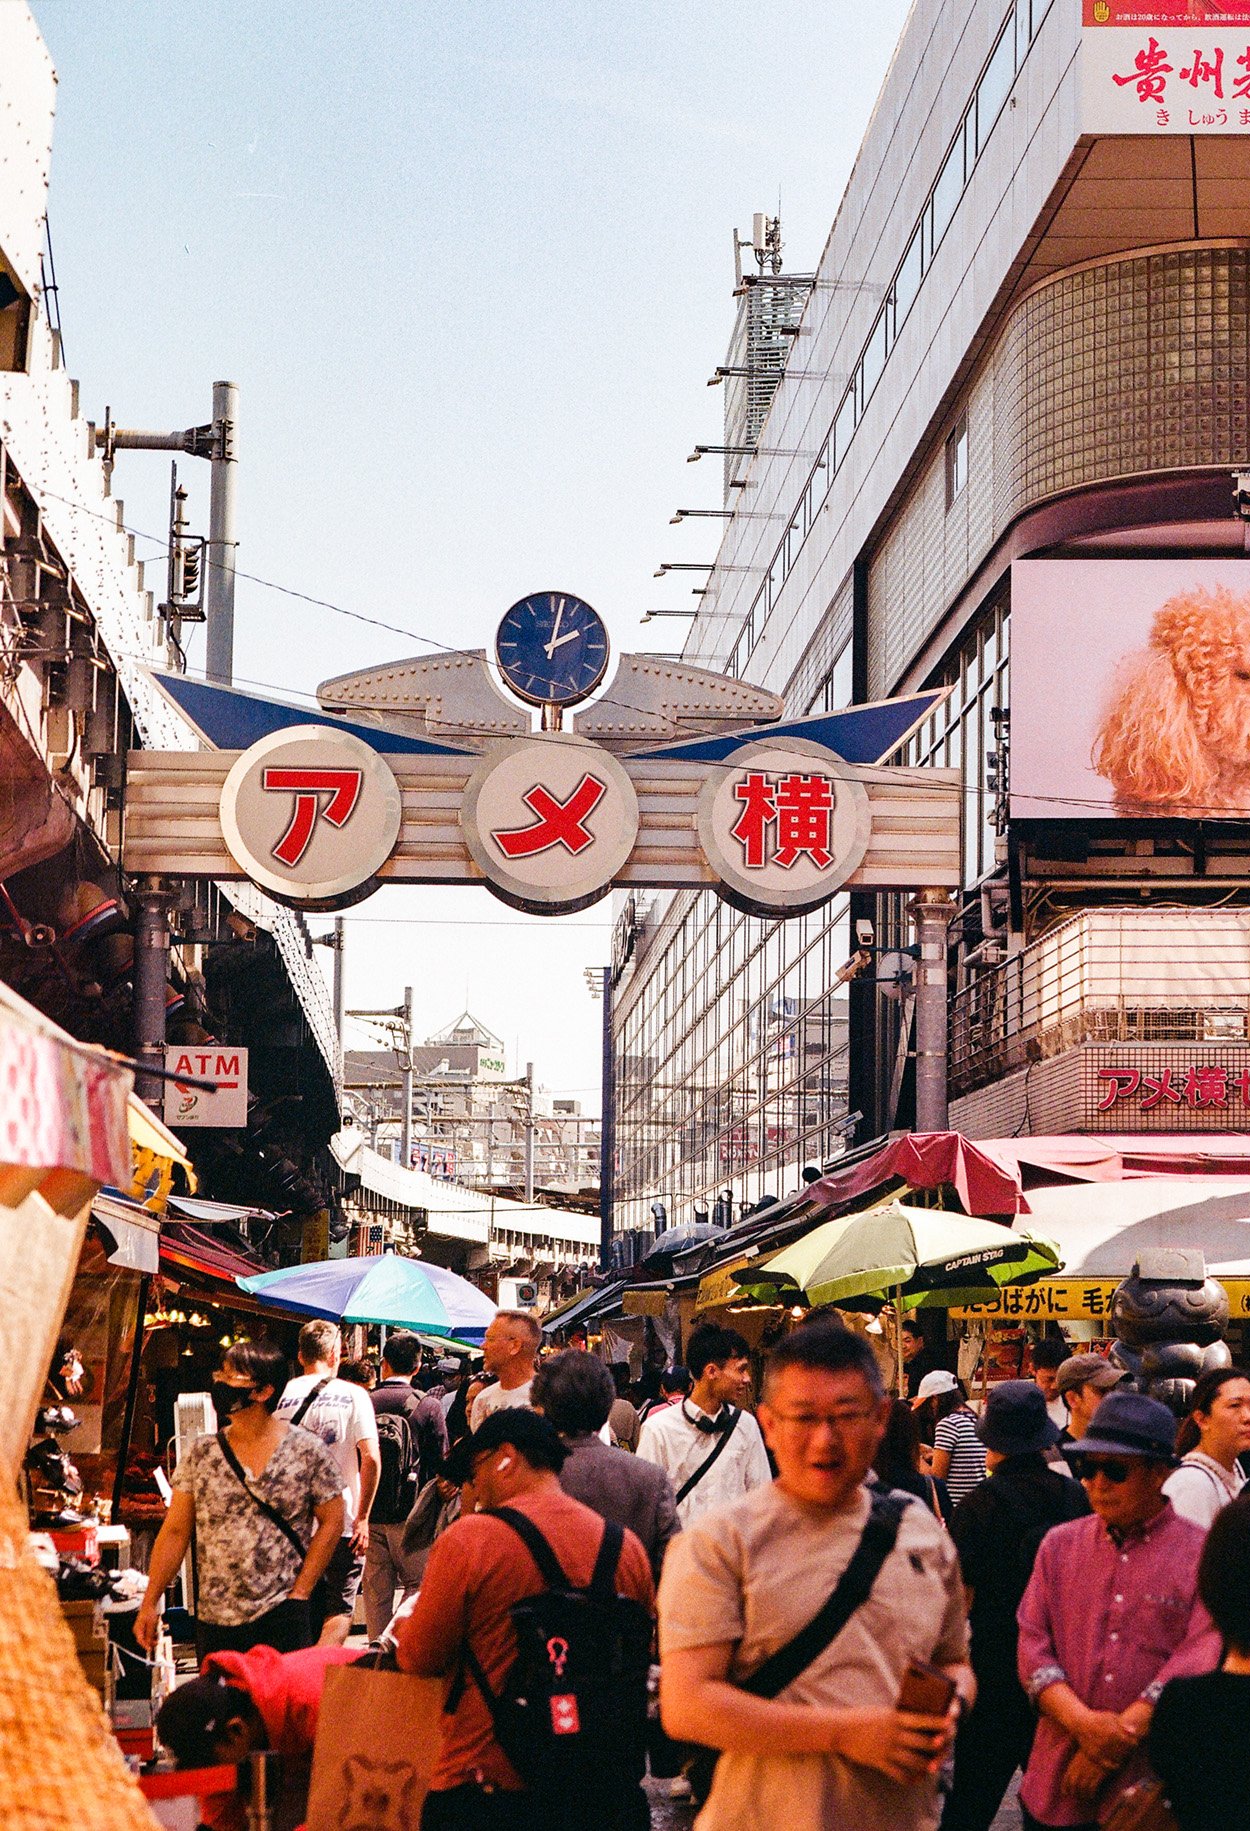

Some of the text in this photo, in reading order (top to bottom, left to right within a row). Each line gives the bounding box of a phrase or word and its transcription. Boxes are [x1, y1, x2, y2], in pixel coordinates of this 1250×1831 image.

[175, 1054, 240, 1076] ATM
[944, 1249, 1004, 1272] CAPTAIN STAG
